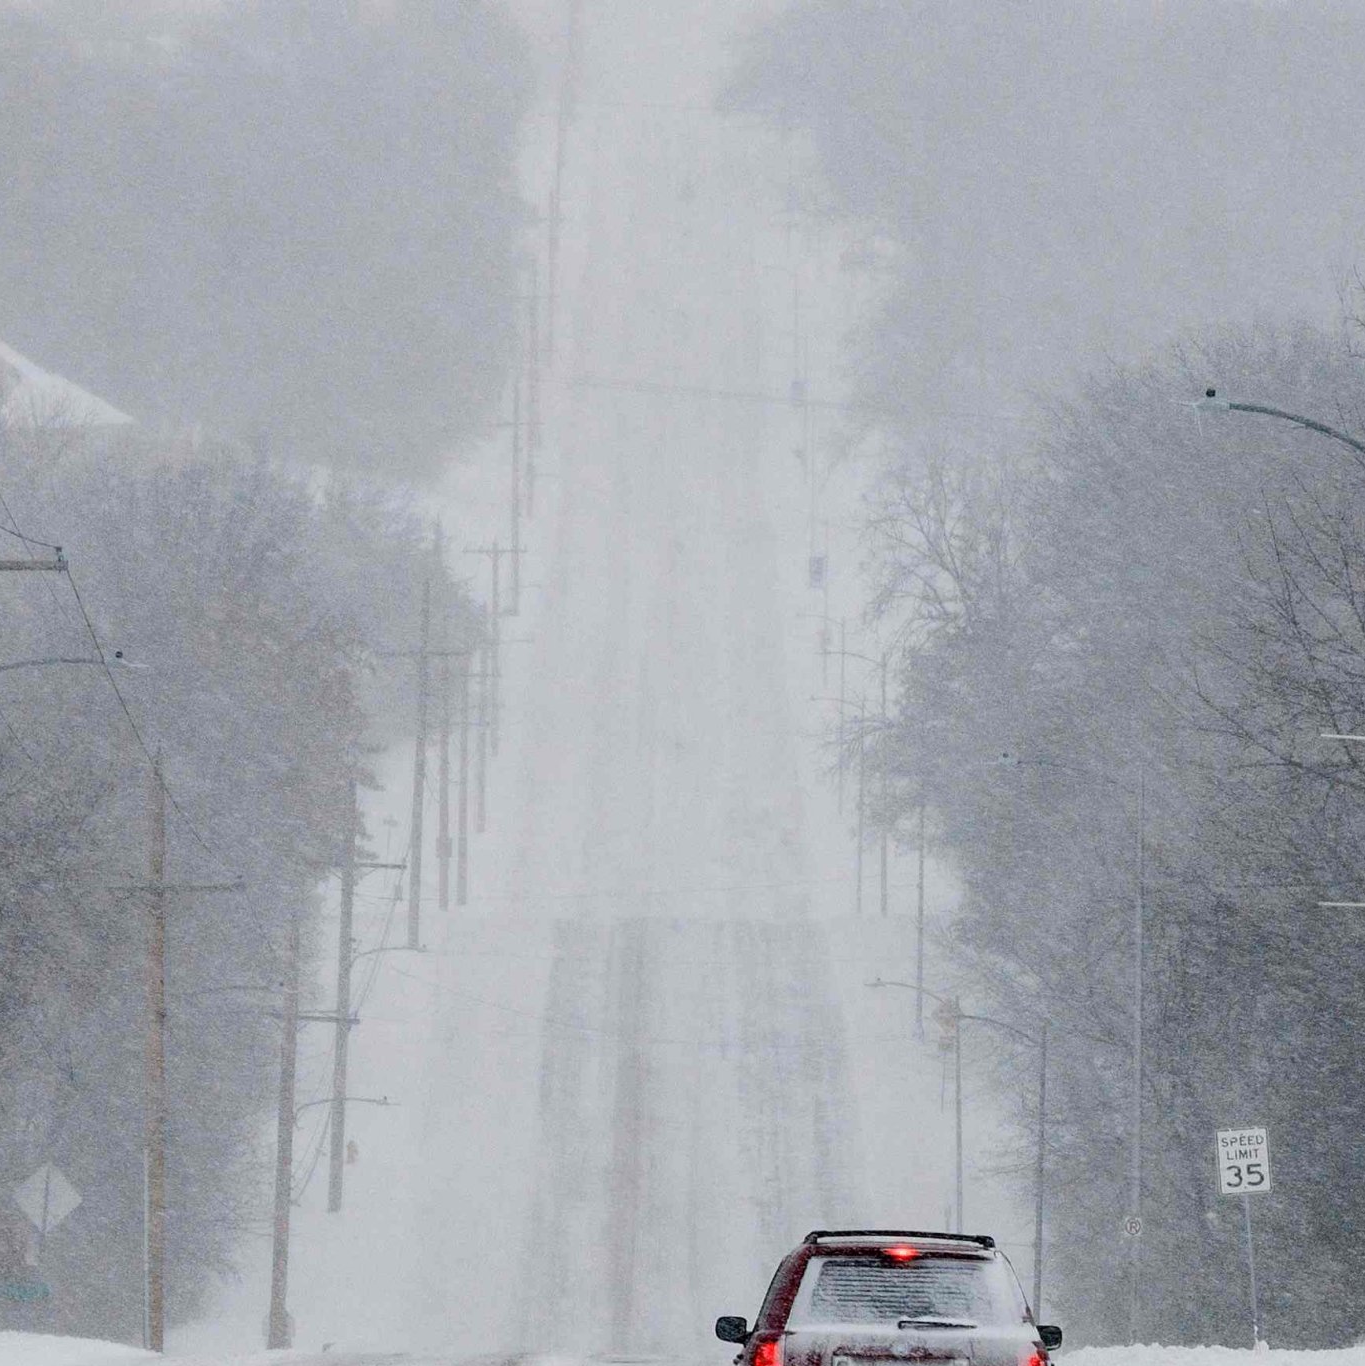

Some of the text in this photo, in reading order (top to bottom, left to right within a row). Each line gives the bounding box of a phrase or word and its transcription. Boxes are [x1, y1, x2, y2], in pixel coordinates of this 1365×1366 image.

[1221, 1134, 1264, 1148] SPEED
[1226, 1148, 1260, 1160] LIMIT
[1226, 1163, 1265, 1187] 35
